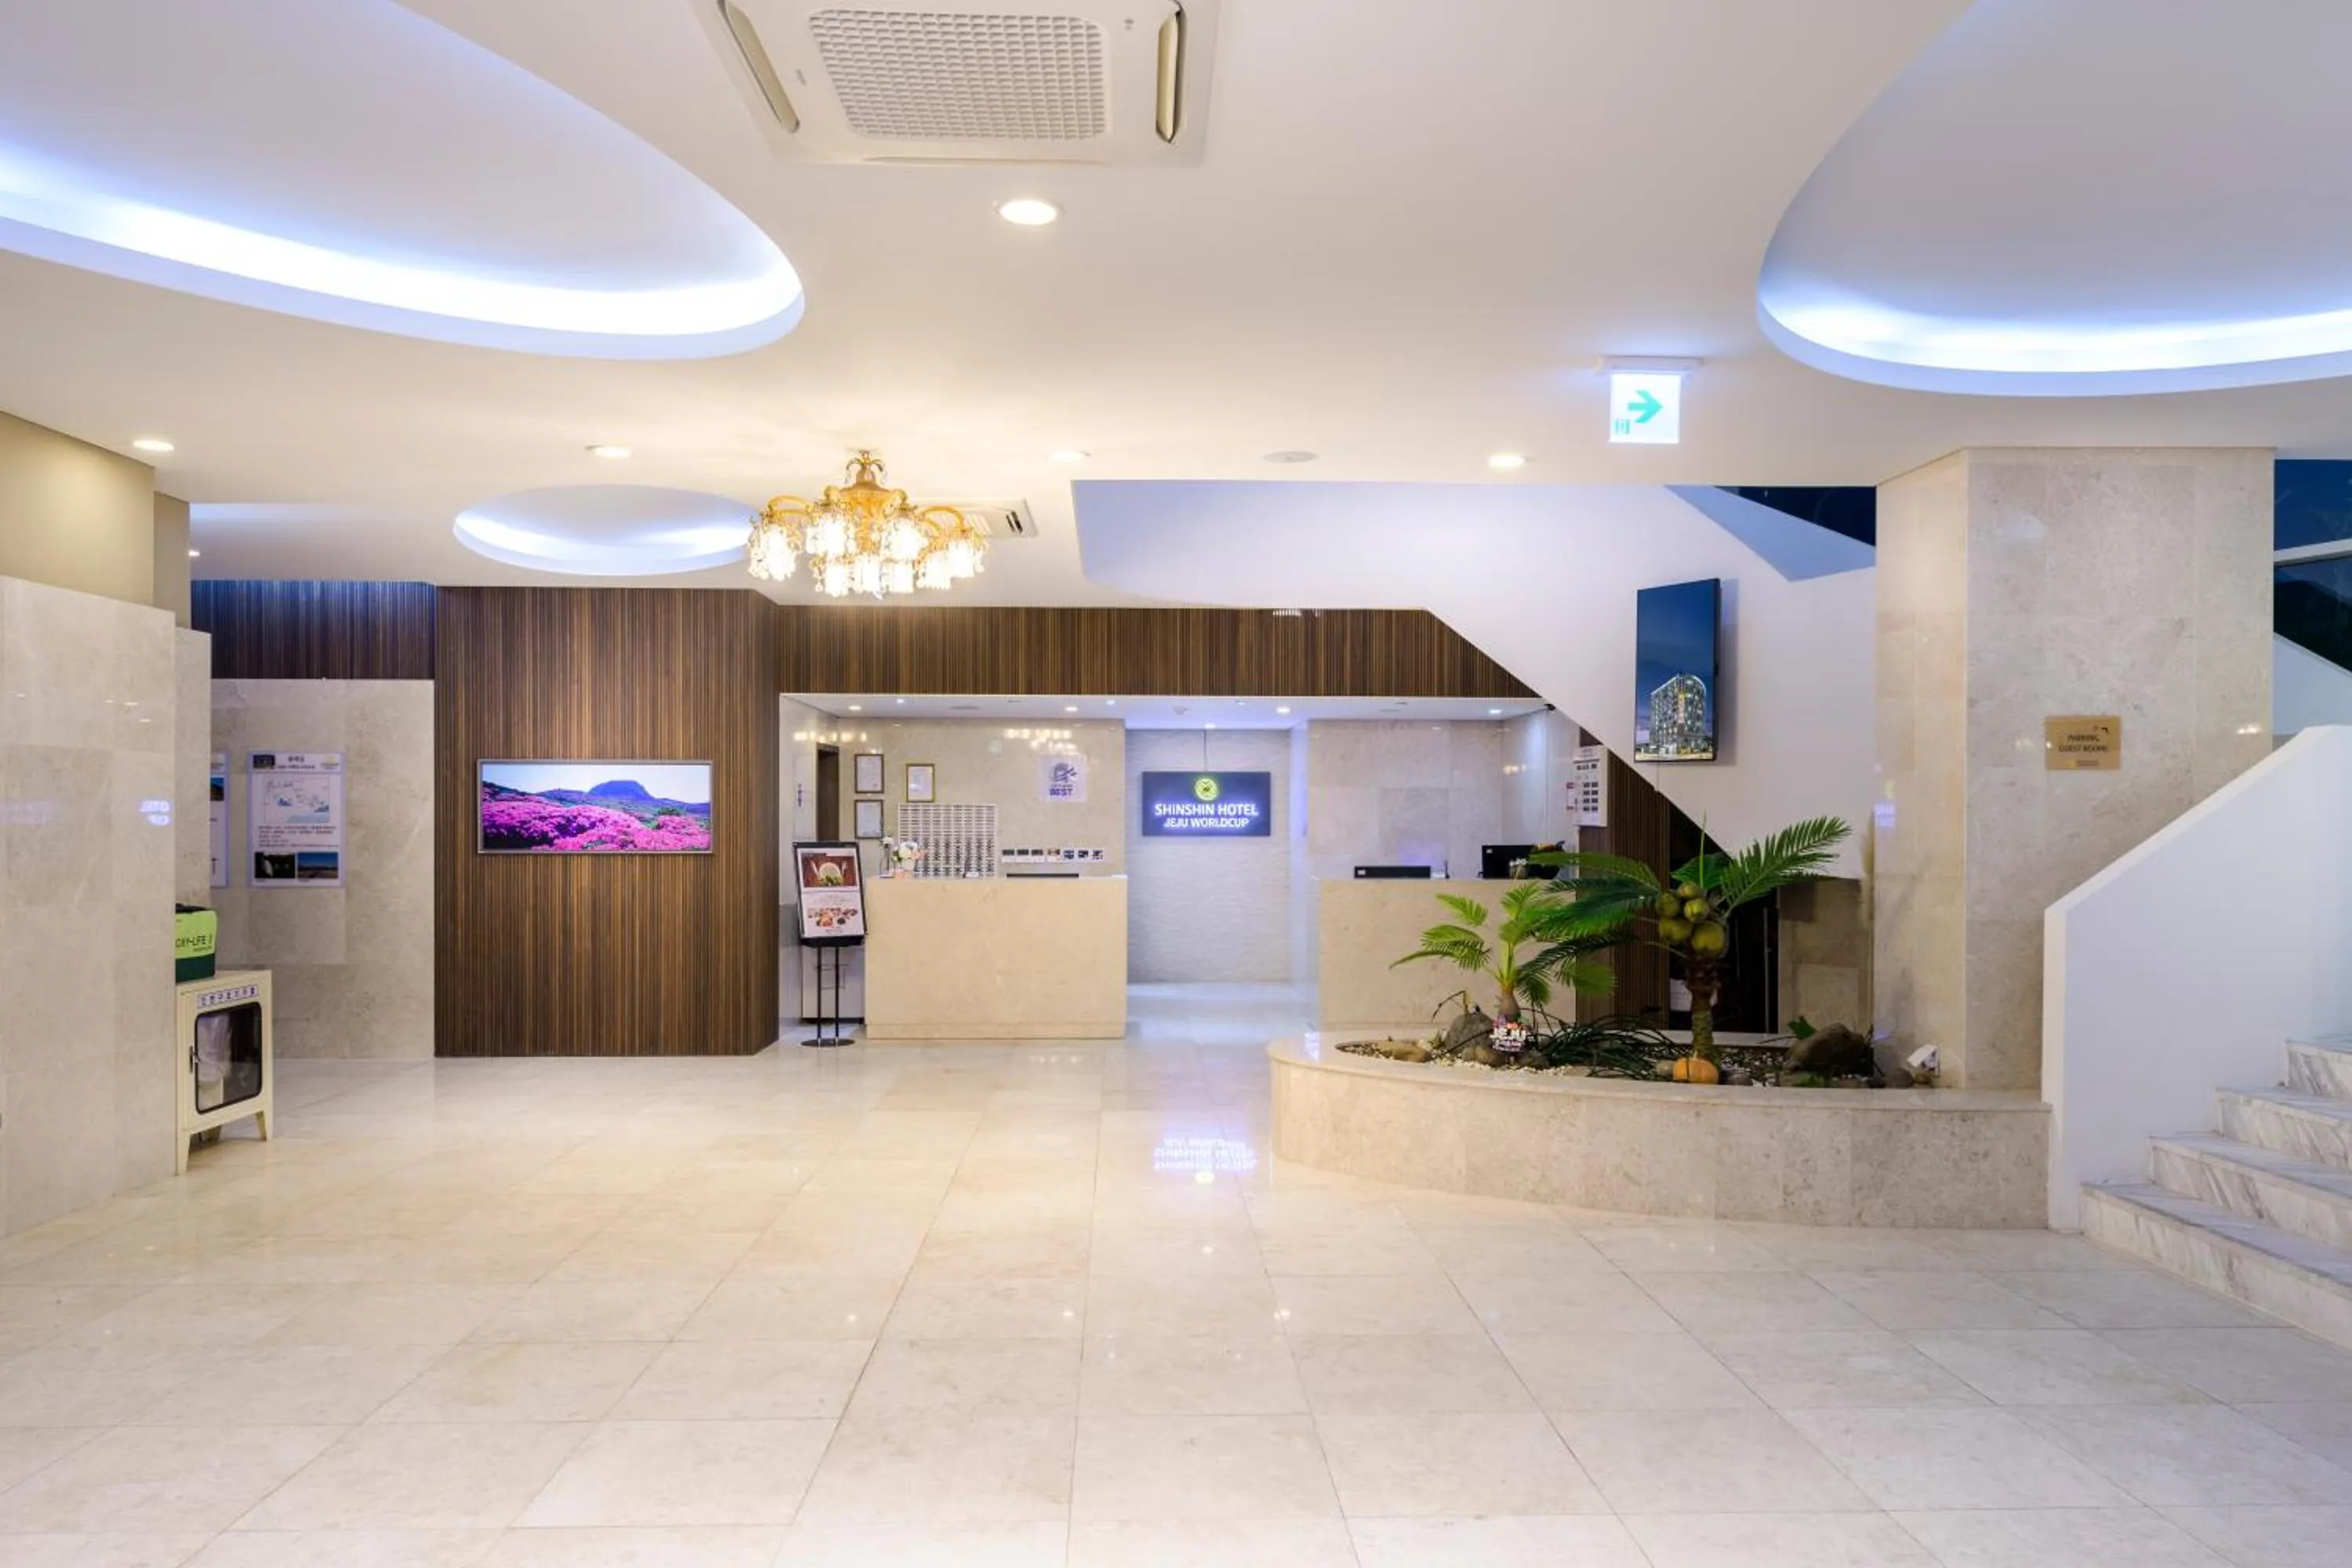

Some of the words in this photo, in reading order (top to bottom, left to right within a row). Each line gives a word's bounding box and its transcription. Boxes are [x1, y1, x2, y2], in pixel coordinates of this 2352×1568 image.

[1154, 803, 1214, 816] SHINSHIN
[1217, 803, 1259, 816] HOTEL
[1163, 818, 1189, 828] JEJU
[1189, 818, 1250, 828] WORLDCUP
